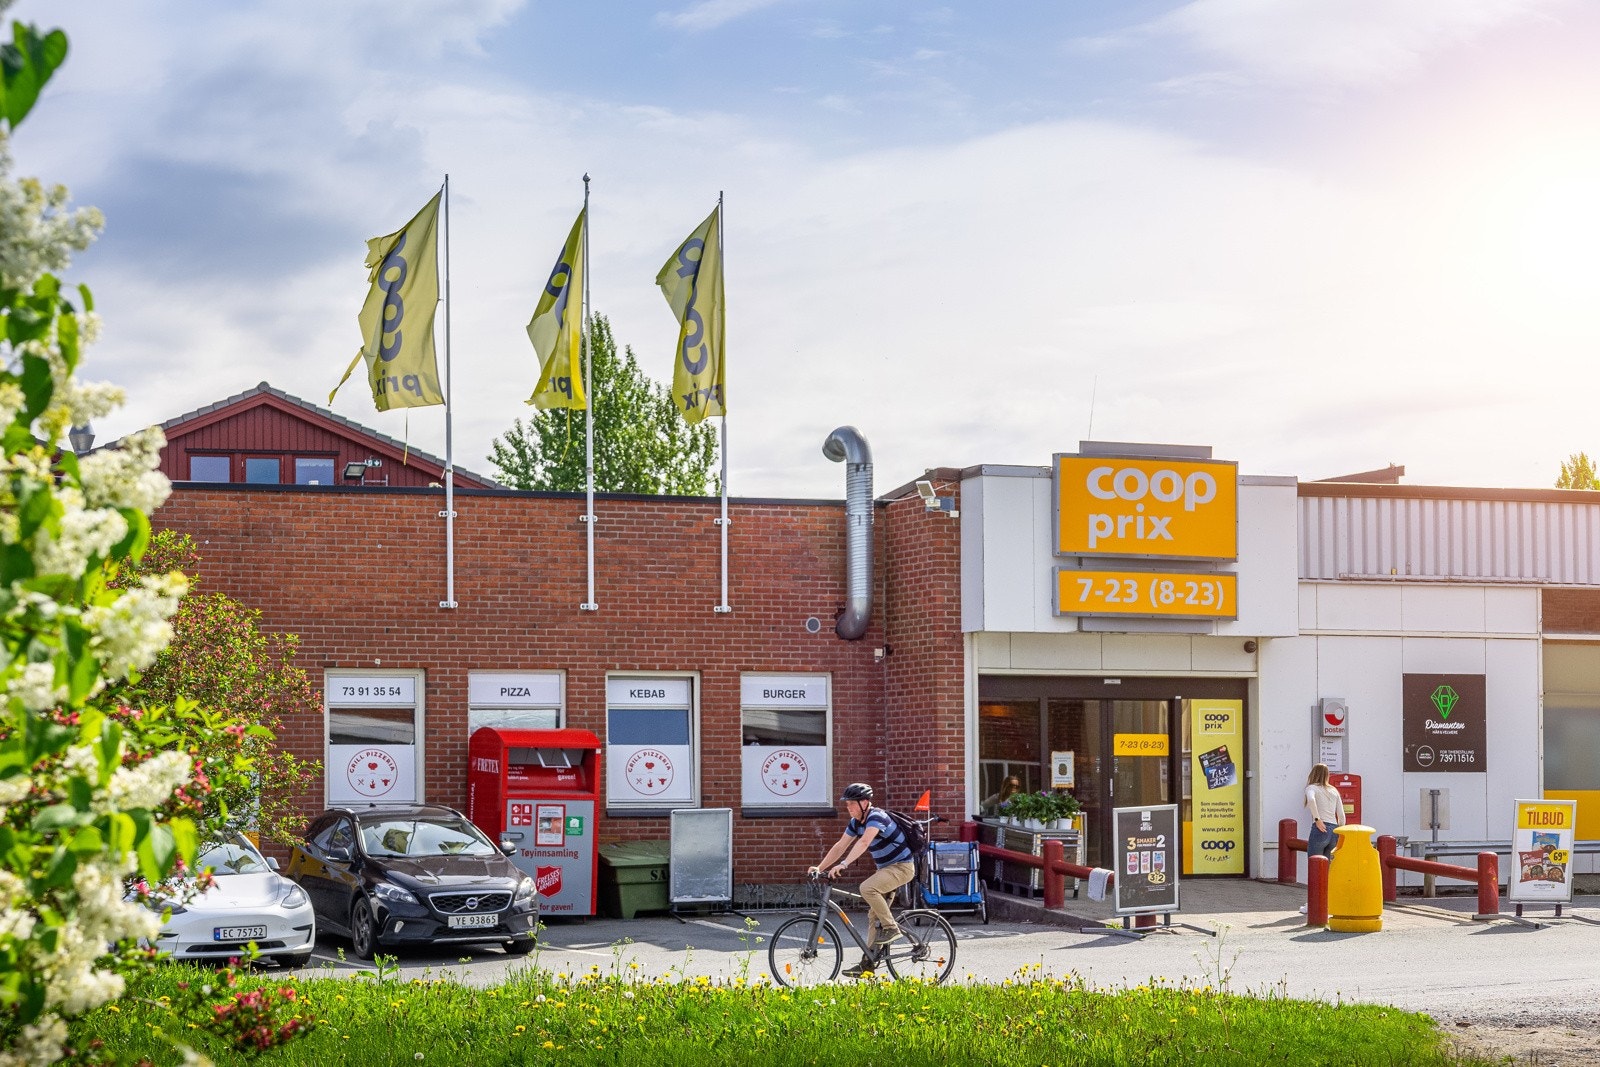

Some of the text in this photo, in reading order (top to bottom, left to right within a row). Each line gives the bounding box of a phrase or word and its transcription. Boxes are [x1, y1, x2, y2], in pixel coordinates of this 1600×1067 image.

[1087, 466, 1217, 511] coop
[1088, 503, 1174, 549] prix
[1077, 579, 1224, 610] 7-23 (8-23)
[342, 686, 401, 696] 73 91 35 54
[500, 687, 531, 697] PIZZA
[629, 689, 666, 699] KEBAB
[763, 689, 806, 699] BURGER
[1204, 713, 1230, 723] coop
[1204, 721, 1222, 731] prix
[1425, 719, 1465, 729] Diamanten
[1139, 740, 1164, 750] (8-23)
[349, 752, 395, 773] GRILL PIZZERIA
[628, 752, 671, 773] GRILL PIZZERIA
[763, 752, 806, 774] GRILL PIZZERIA
[1440, 754, 1475, 763] 73911516
[1526, 811, 1564, 826] TILBUD
[1127, 837, 1136, 850] 3
[1156, 834, 1166, 848] 2
[1201, 840, 1236, 852] coop
[520, 848, 579, 859] Tøyinnsamling
[539, 903, 574, 912] for gaven!
[470, 915, 496, 925] 93865
[223, 928, 263, 938] EC 75752
